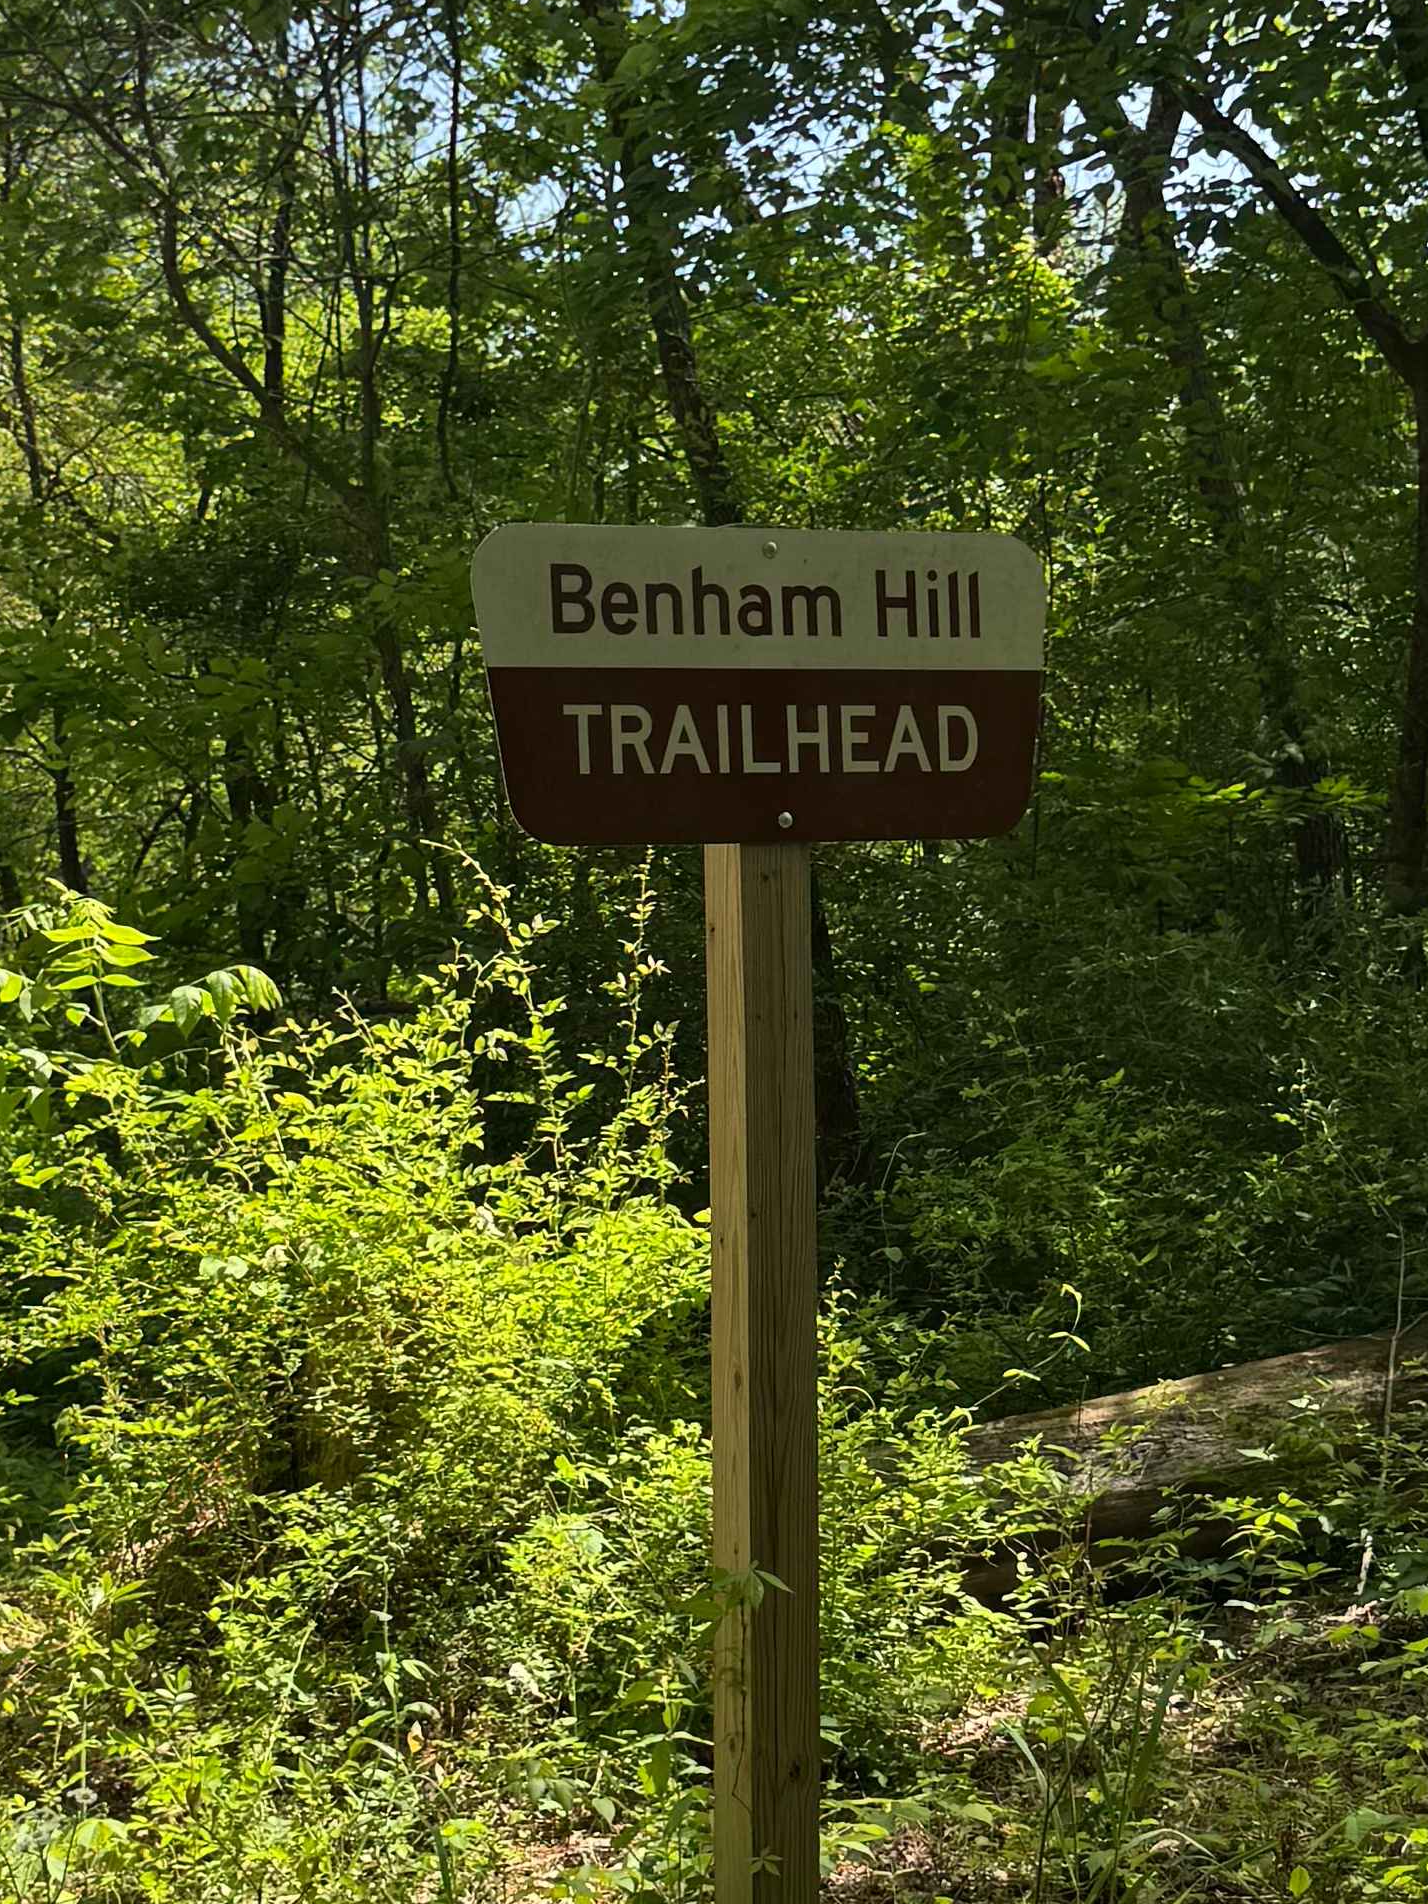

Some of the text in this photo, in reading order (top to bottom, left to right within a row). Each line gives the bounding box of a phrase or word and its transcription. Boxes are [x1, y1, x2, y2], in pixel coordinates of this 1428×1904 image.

[549, 563, 981, 638] Benham Hill
[563, 704, 979, 774] TRAILHEAD
